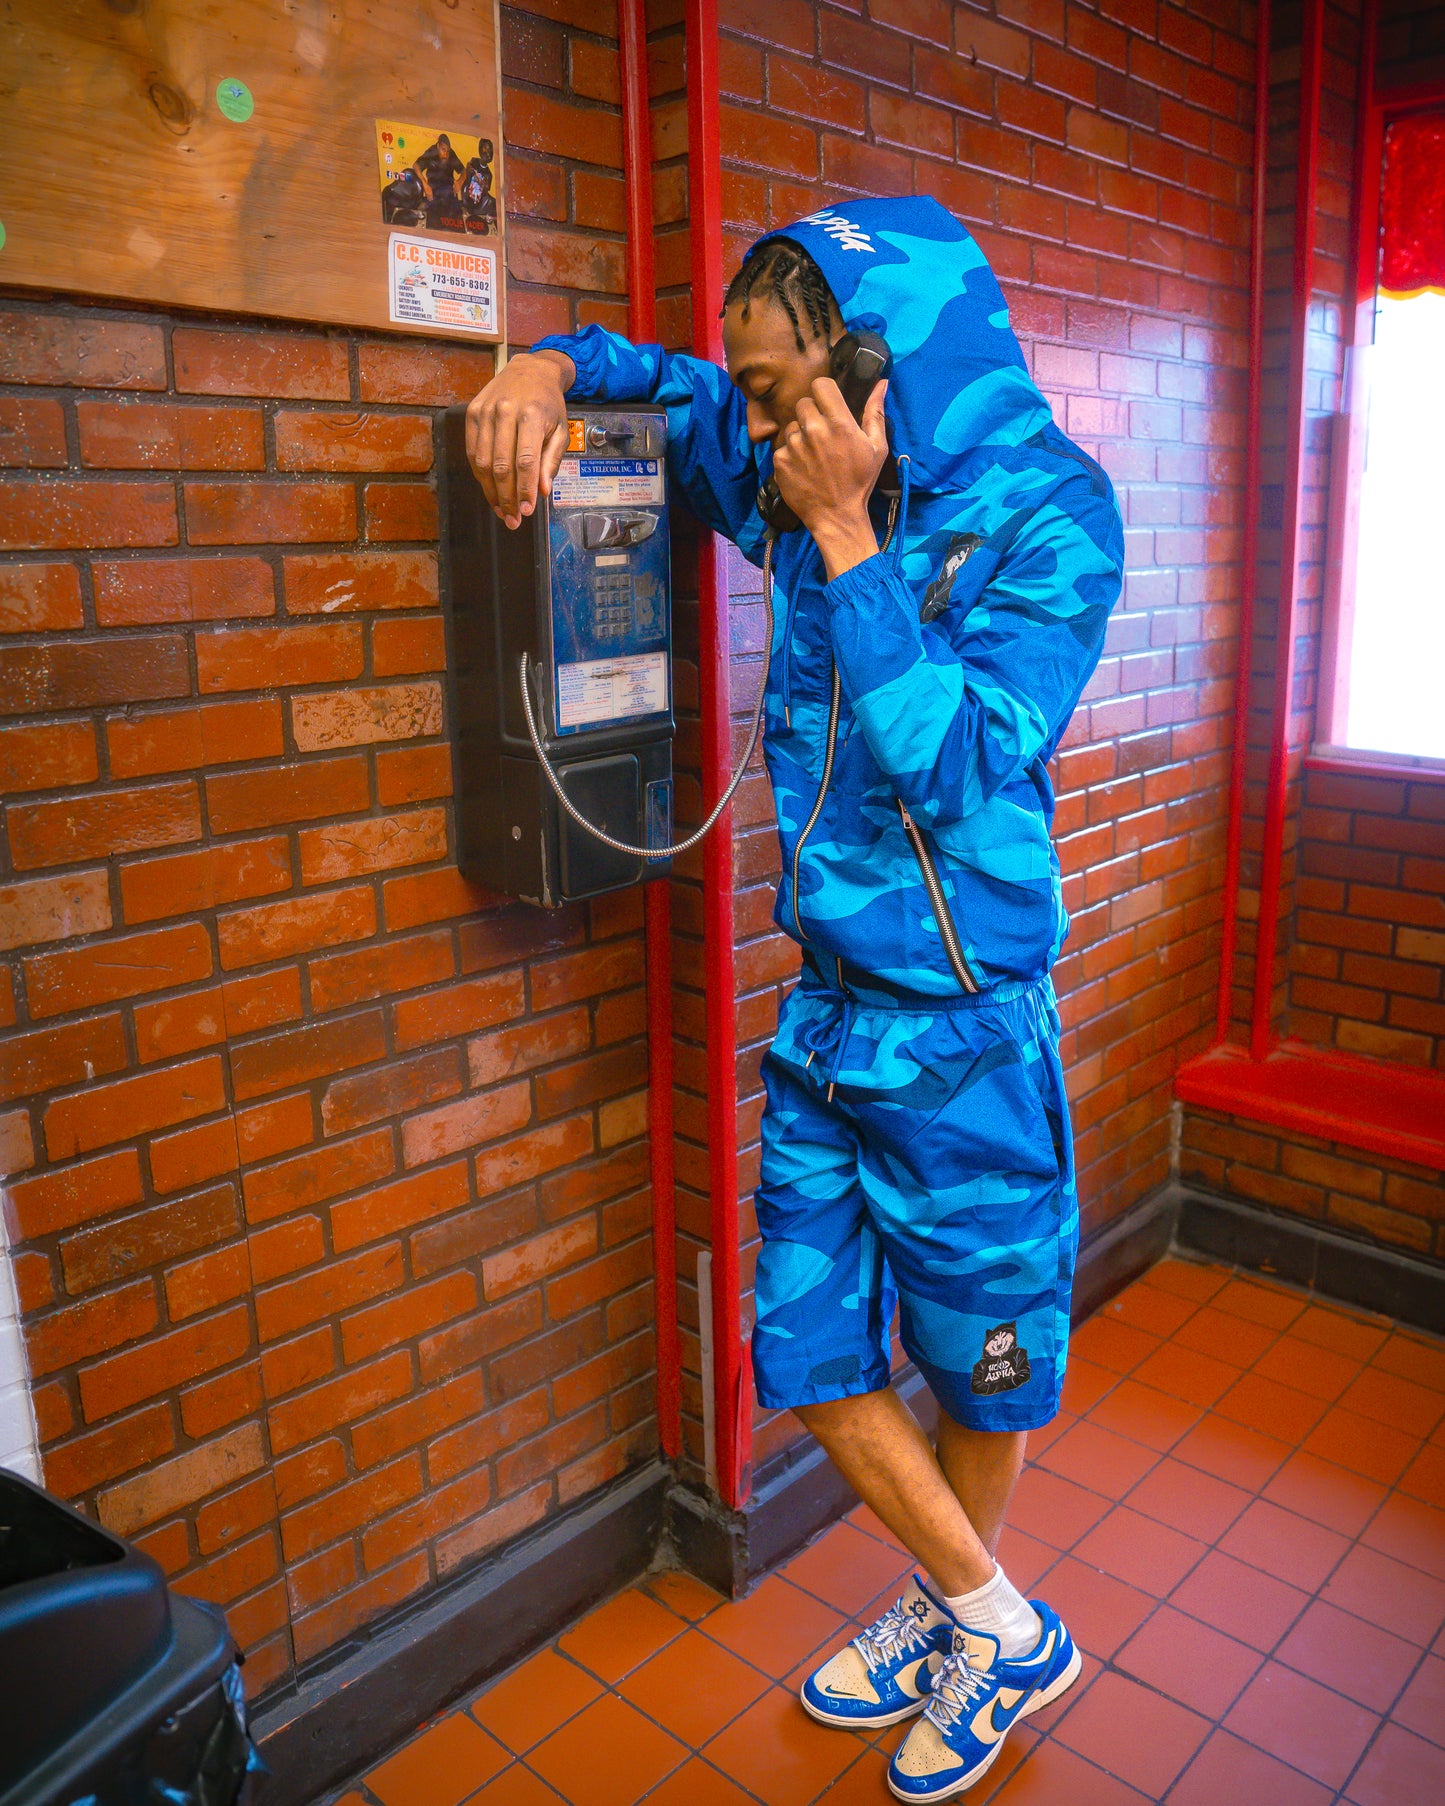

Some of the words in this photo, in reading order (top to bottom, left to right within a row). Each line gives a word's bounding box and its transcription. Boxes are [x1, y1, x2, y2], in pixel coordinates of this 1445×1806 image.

[397, 244, 423, 263] C.C.
[426, 250, 489, 274] SERVICES
[432, 273, 489, 291] 773-655-8302
[984, 1367, 1016, 1382] ALPHA
